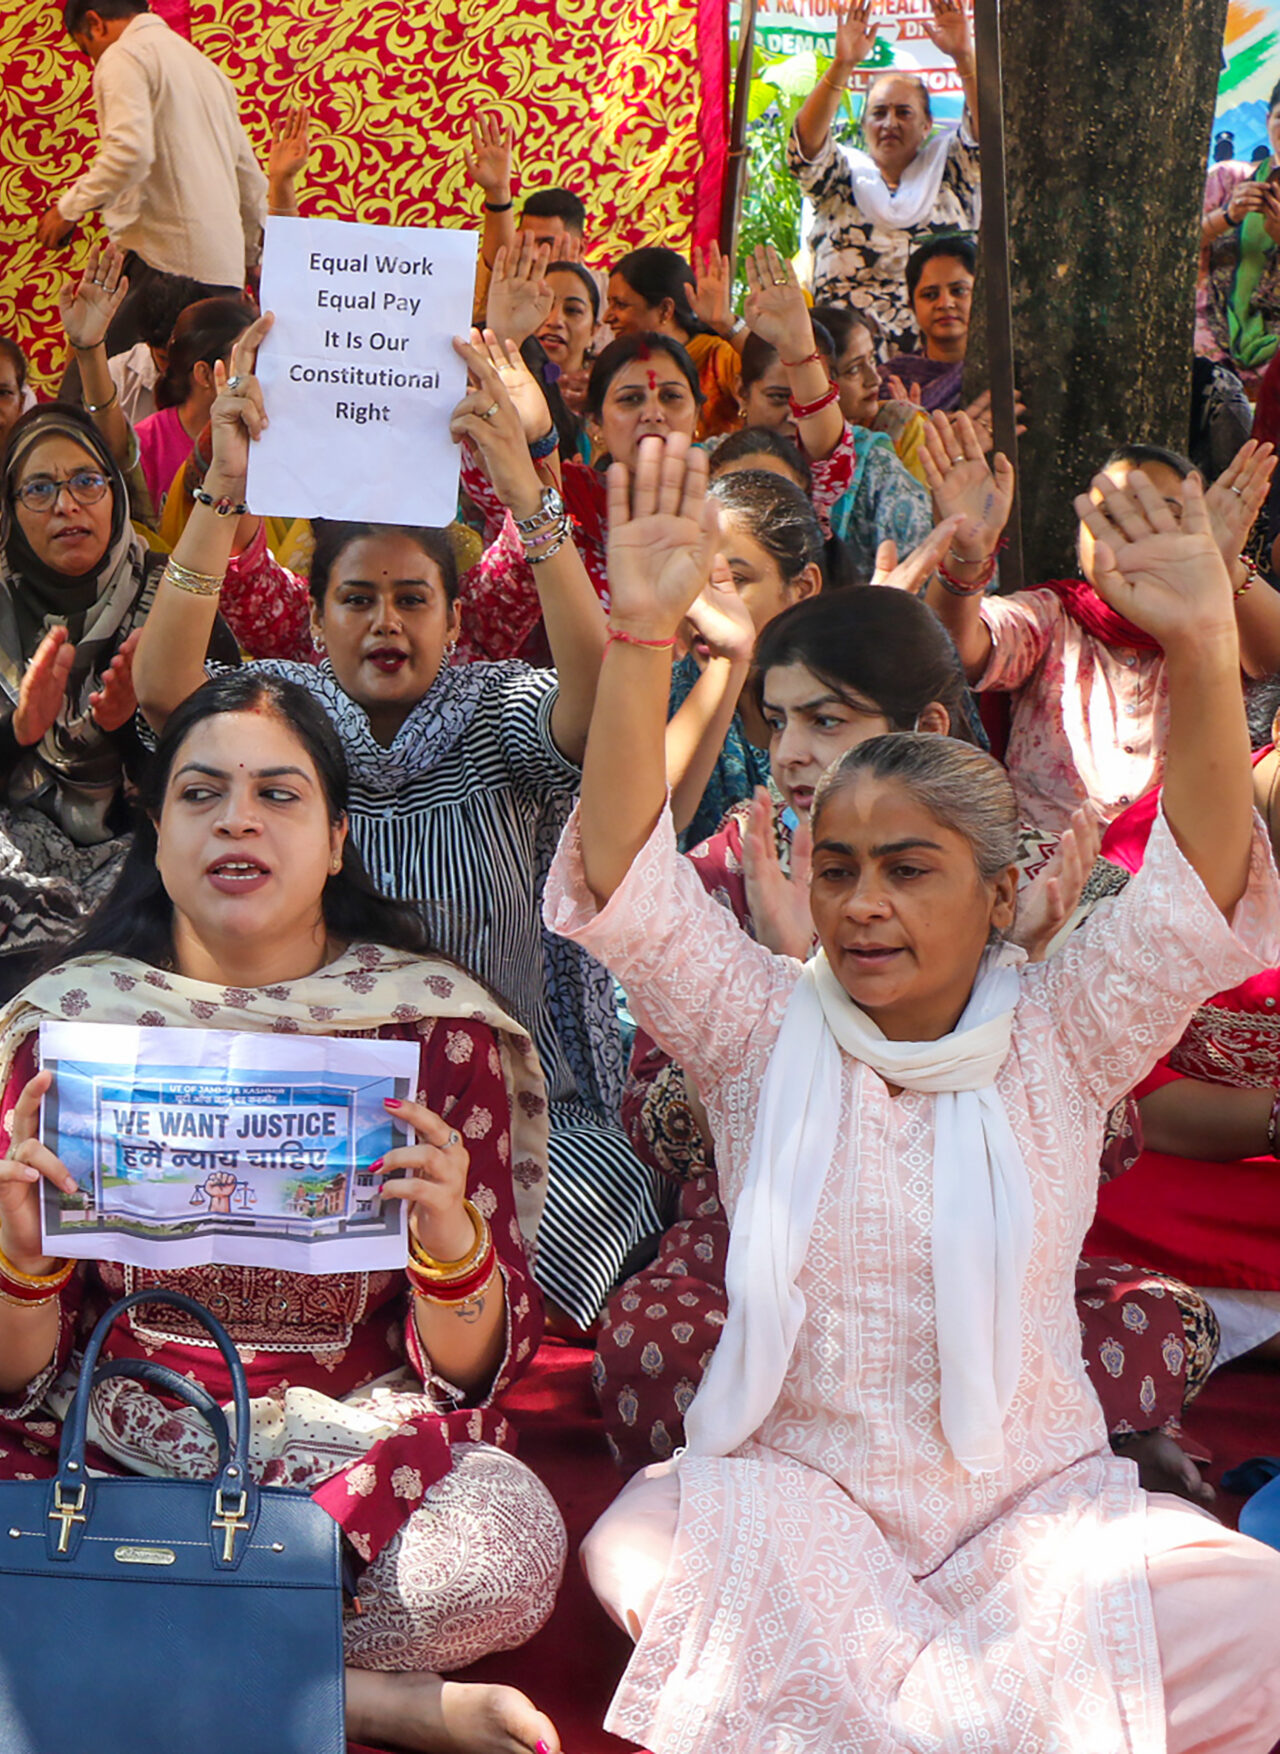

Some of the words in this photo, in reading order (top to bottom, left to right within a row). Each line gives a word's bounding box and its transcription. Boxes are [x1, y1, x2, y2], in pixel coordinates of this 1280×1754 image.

[309, 252, 368, 275] Equal
[375, 255, 434, 276] Work
[317, 290, 376, 312] Equal
[383, 293, 421, 315] Pay
[324, 330, 340, 348] It
[347, 332, 362, 349] Is
[370, 332, 410, 351] Our
[289, 364, 440, 389] Constitutional
[336, 401, 391, 424] Right
[169, 1085, 182, 1093] UT
[183, 1085, 197, 1093] OF
[199, 1086, 232, 1095] JAMMU
[113, 1109, 150, 1136] WE
[159, 1111, 229, 1138] WANT
[236, 1112, 336, 1138] JUSTICE
[120, 1140, 168, 1169] हमें
[170, 1147, 239, 1169] न्याय
[246, 1140, 327, 1171] चाहिए
